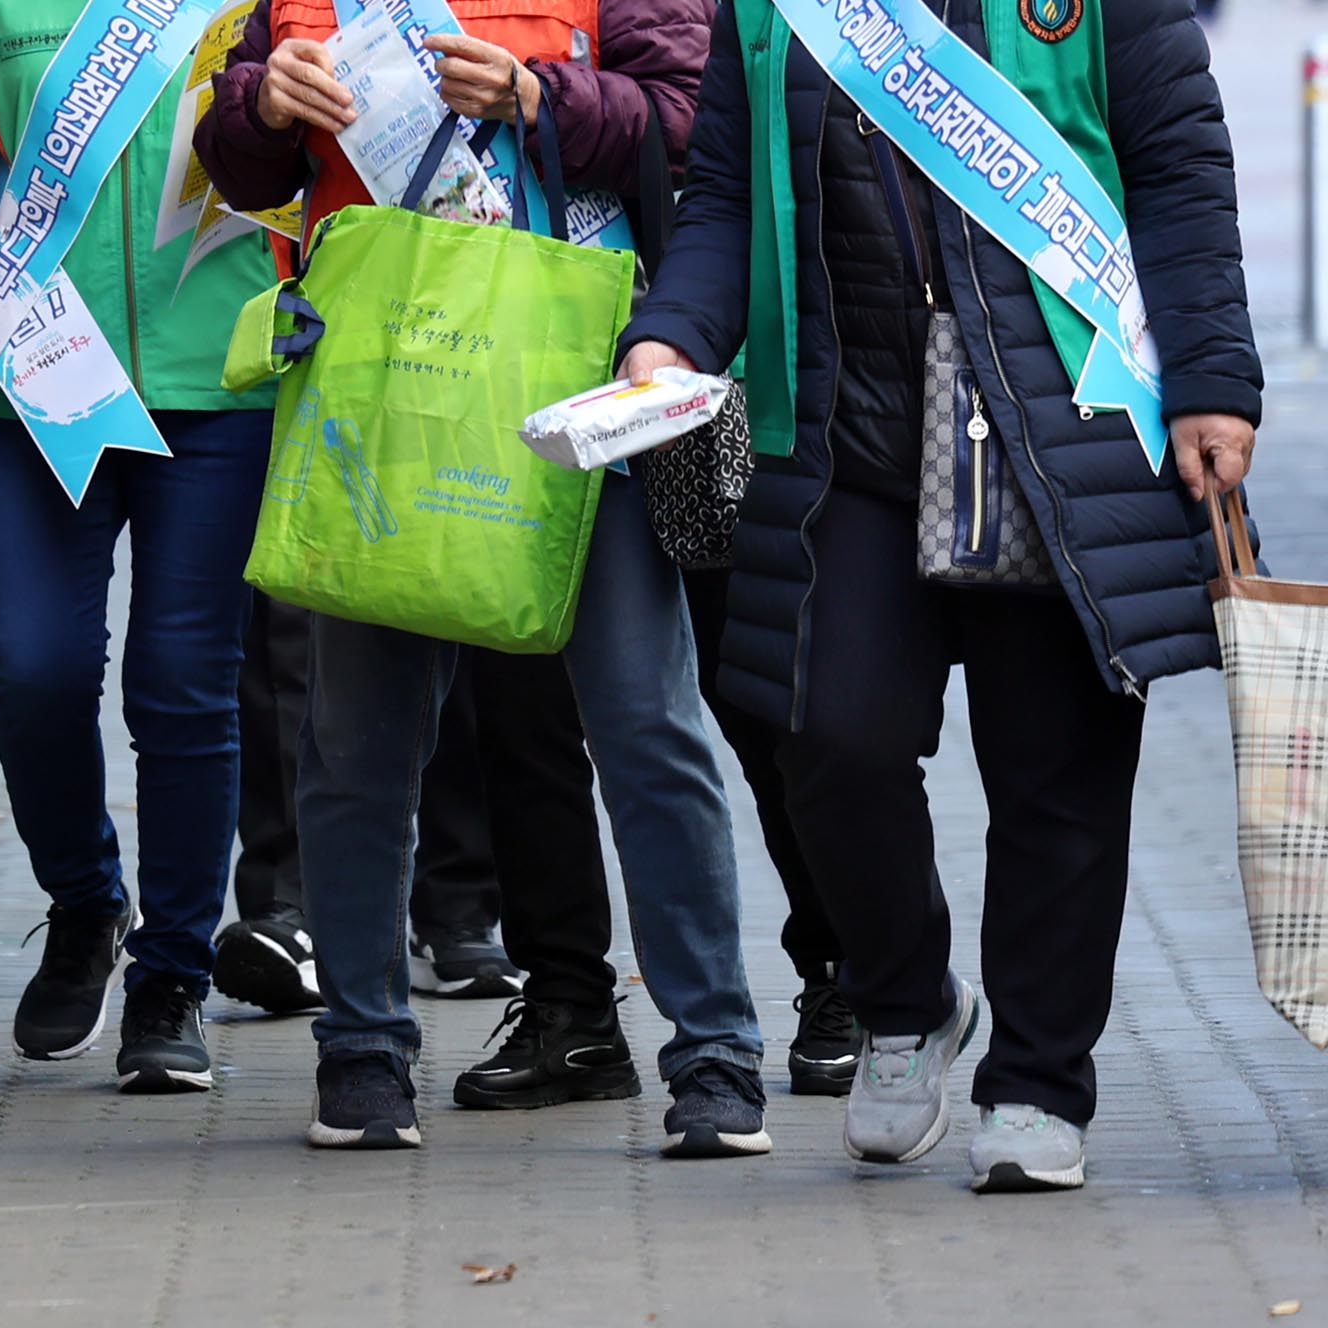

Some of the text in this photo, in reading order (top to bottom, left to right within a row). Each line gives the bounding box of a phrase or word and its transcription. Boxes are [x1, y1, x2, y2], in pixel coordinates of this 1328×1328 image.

[39, 16, 157, 179] 안전점검의
[882, 45, 1043, 203] 안전점검의
[1018, 171, 1136, 308] 날입니다
[417, 485, 455, 503] Cooking
[436, 464, 512, 496] cooking
